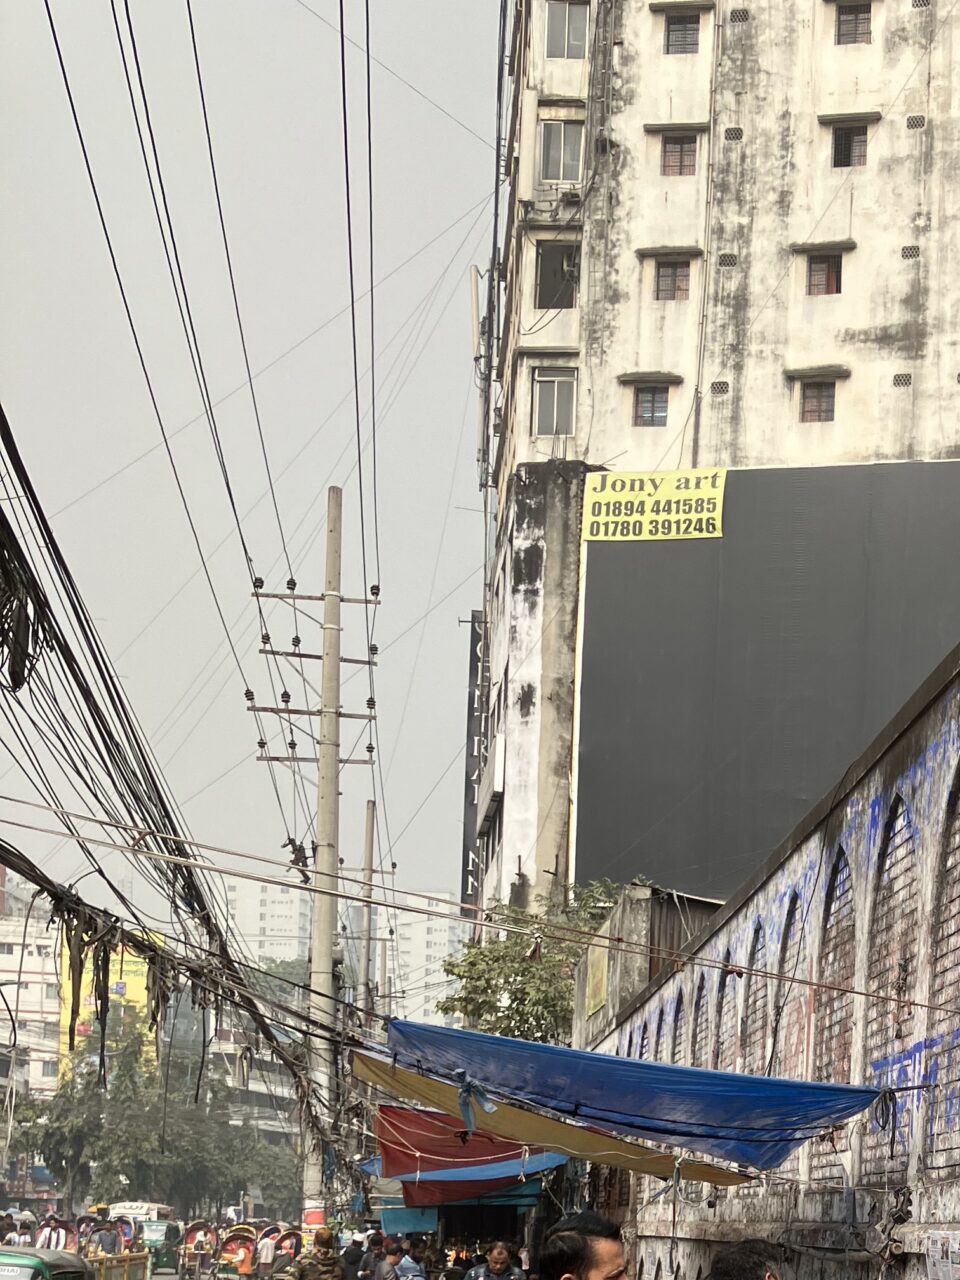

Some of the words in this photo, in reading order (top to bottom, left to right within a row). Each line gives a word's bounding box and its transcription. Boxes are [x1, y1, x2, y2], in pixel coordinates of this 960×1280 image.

[592, 474, 665, 497] Jony
[675, 471, 721, 490] art
[592, 500, 645, 517] 01894
[651, 498, 716, 515] 441585
[590, 520, 643, 536] 01780
[649, 517, 716, 535] 391246
